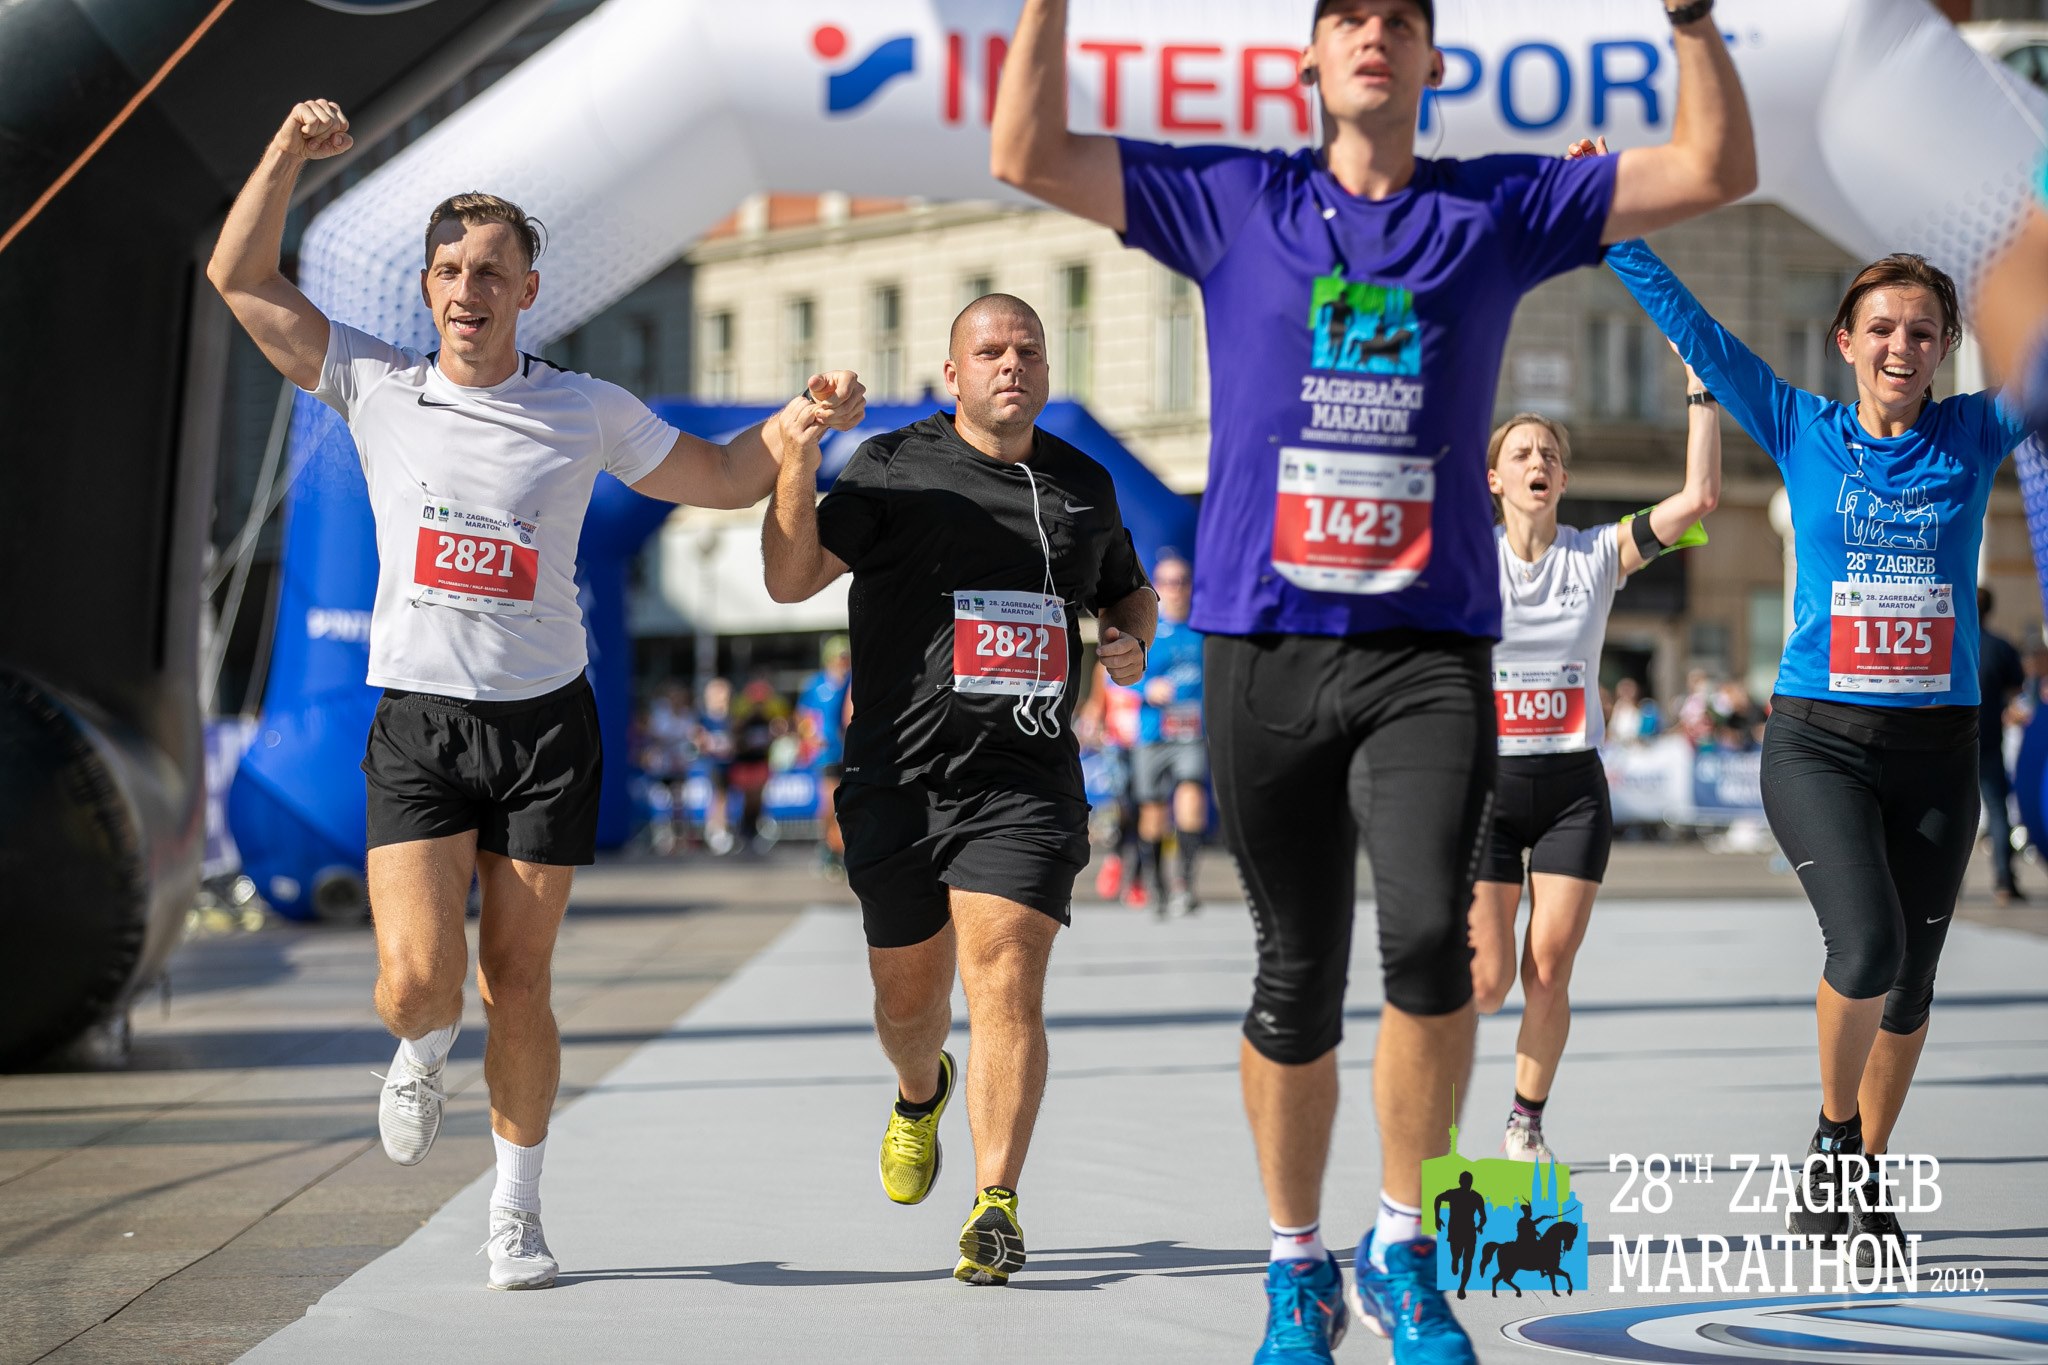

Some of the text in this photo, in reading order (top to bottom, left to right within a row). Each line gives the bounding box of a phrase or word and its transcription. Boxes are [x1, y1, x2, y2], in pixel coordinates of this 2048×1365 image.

[944, 32, 1737, 132] ITERPOR
[1301, 375, 1424, 410] ZAGREBAČKI
[1311, 402, 1410, 434] MARATON
[453, 511, 466, 519] 28.
[466, 513, 510, 529] ZAGREBAČKI
[465, 520, 501, 532] MARATON
[1303, 498, 1404, 547] 1423
[435, 535, 514, 578] 2821
[1846, 551, 1936, 574] 28TH ZAGREB
[1000, 600, 1042, 610] ZAGREBAČKI
[1000, 608, 1034, 616] MARATON
[1878, 594, 1925, 602] ZAGREBAČKI
[976, 624, 1050, 660] 2822
[1854, 620, 1932, 655] 1125
[1502, 691, 1567, 720] 1490
